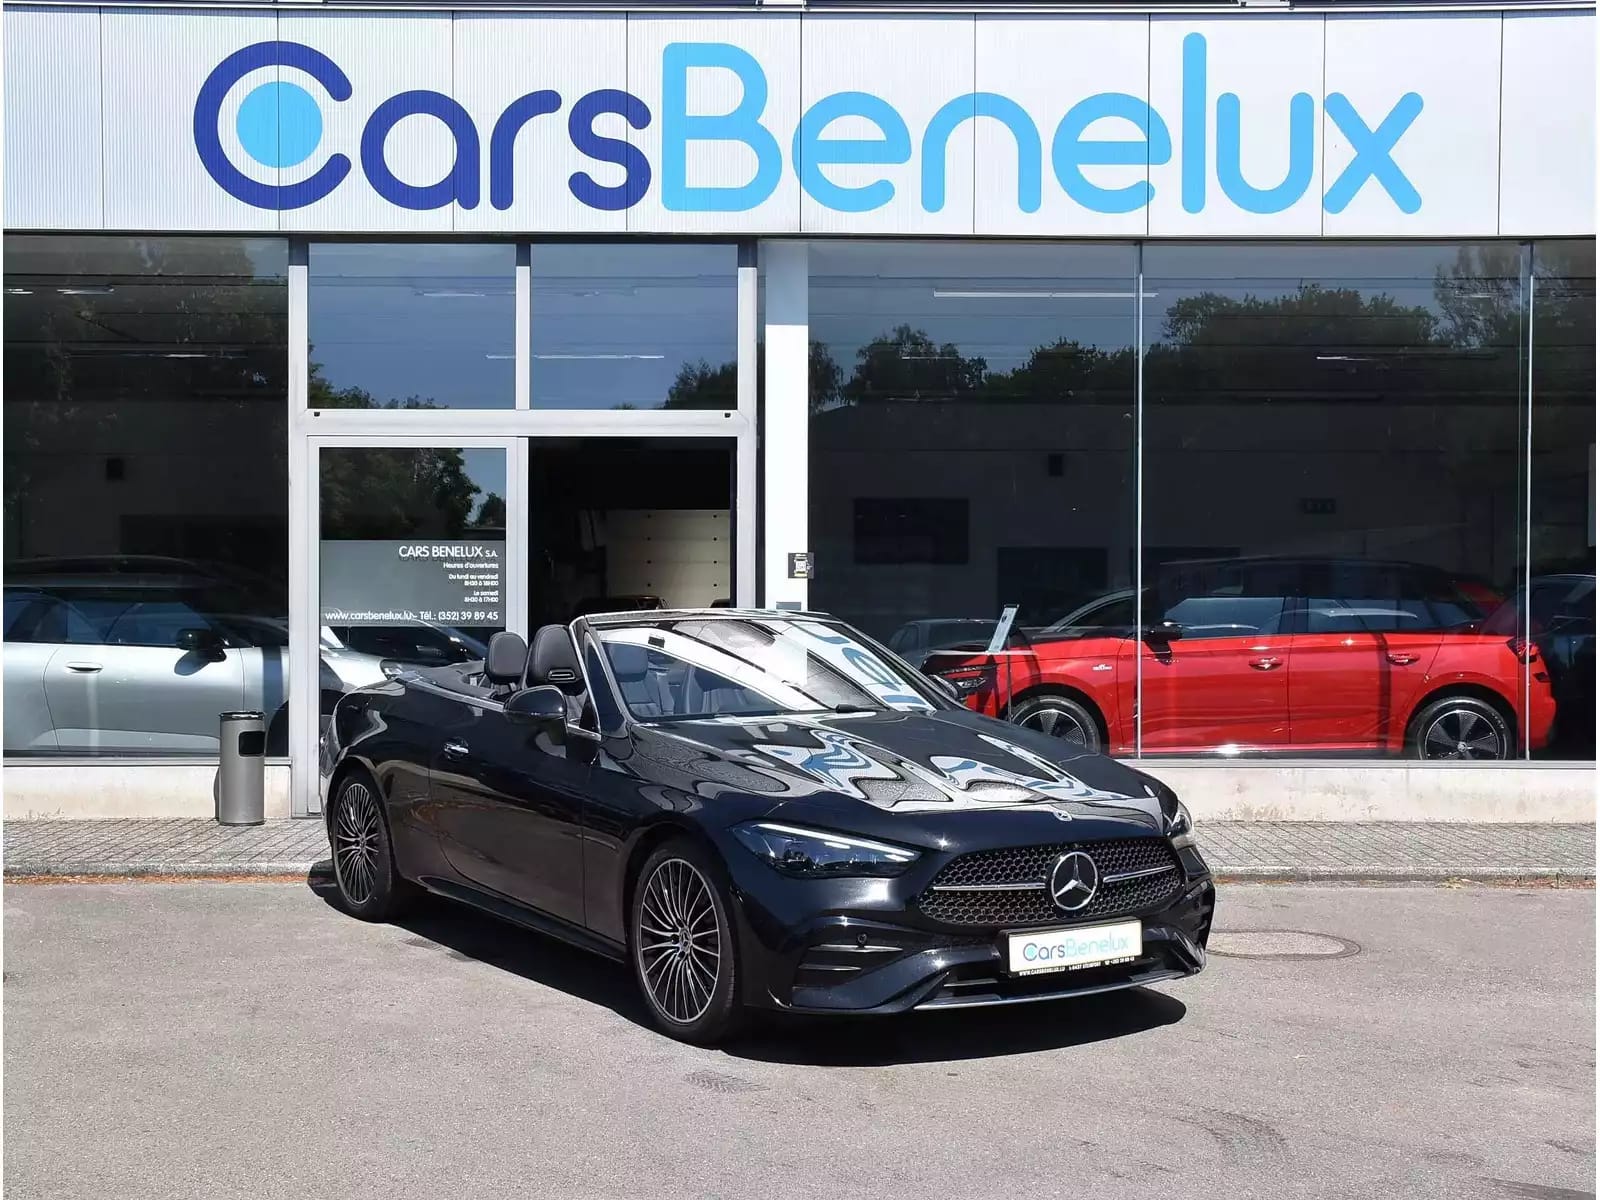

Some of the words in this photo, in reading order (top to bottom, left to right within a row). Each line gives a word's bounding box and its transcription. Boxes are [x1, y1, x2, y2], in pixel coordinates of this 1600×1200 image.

[193, 32, 1425, 215] CarsBenelux
[398, 545, 430, 558] CARS
[431, 545, 483, 558] BENELUX
[325, 611, 412, 621] www.carsbenelux.lu
[438, 611, 459, 621] (352)
[461, 611, 472, 620] 39
[474, 611, 485, 620] 89
[486, 611, 499, 620] 45
[1023, 931, 1129, 961] CarsBenelux
